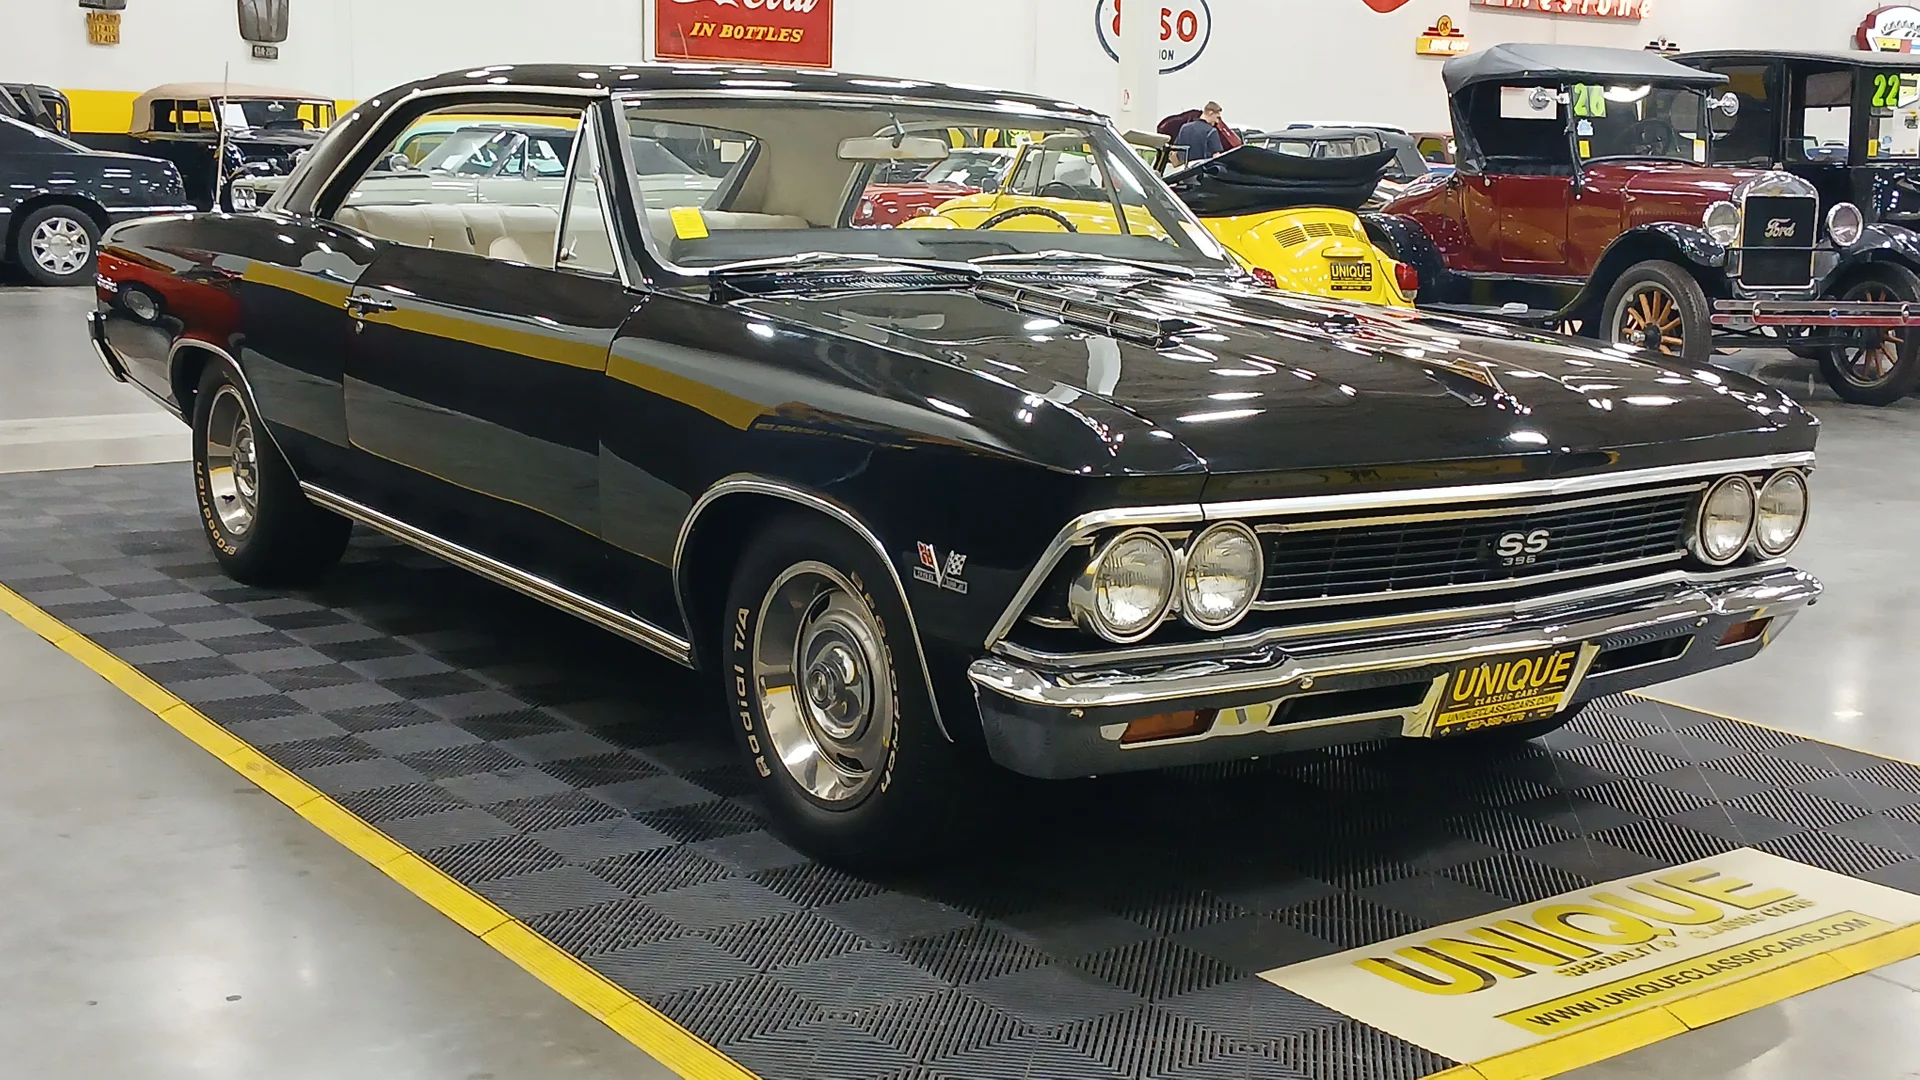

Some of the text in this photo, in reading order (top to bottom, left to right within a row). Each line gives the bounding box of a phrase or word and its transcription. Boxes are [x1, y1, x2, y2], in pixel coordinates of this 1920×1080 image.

[689, 22, 804, 43] IN BOTTLES
[1574, 83, 1605, 116] 26
[1872, 74, 1900, 107] 22
[1764, 218, 1797, 238] Ford
[1331, 264, 1371, 278] UNIQUE
[1496, 529, 1550, 557] SS
[1502, 555, 1537, 567] 396
[1453, 651, 1576, 701] UNIQUE
[1474, 688, 1539, 706] CLASSIC CARS
[1352, 871, 1802, 996] UNIQUE
[1526, 918, 1872, 1028] WWW.UNIQUECLASSICCARS.COM
